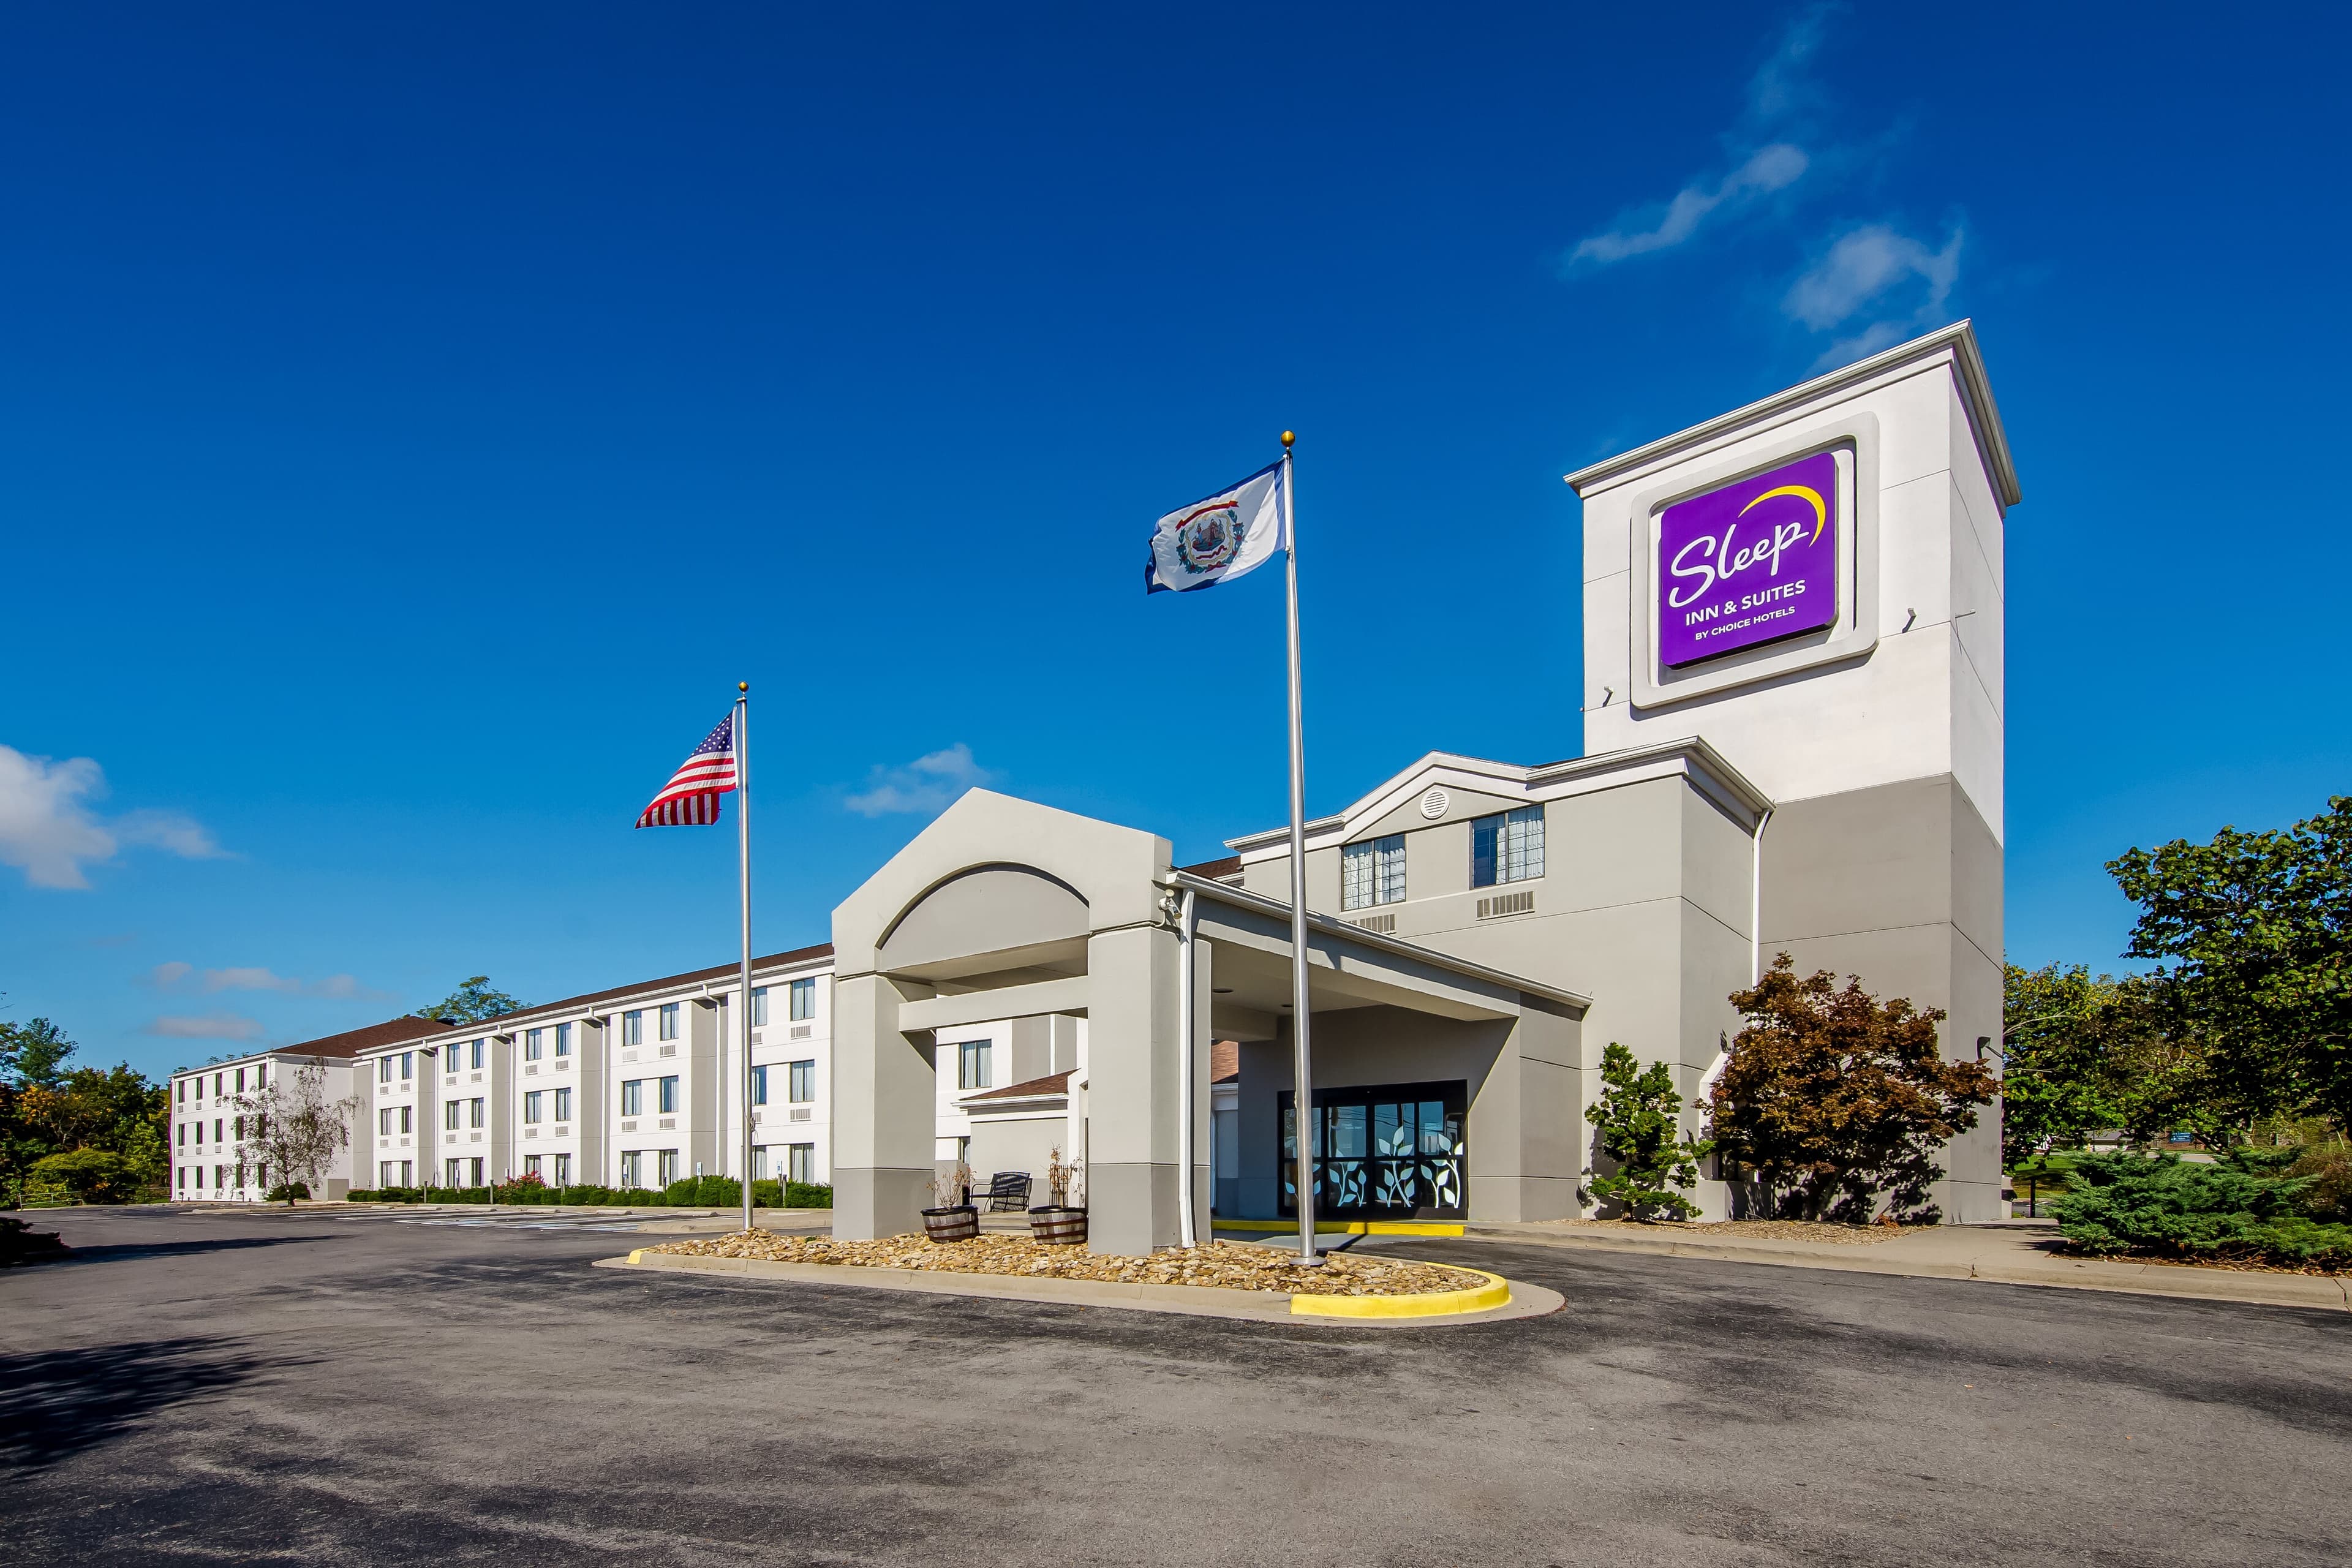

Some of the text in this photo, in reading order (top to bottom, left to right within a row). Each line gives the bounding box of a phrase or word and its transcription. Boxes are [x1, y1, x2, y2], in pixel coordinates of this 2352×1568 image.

[1668, 522, 1809, 608] Sleep
[1686, 579, 1806, 626] INN & SUITES
[1695, 606, 1795, 640] BY CHOICE HOTELS
